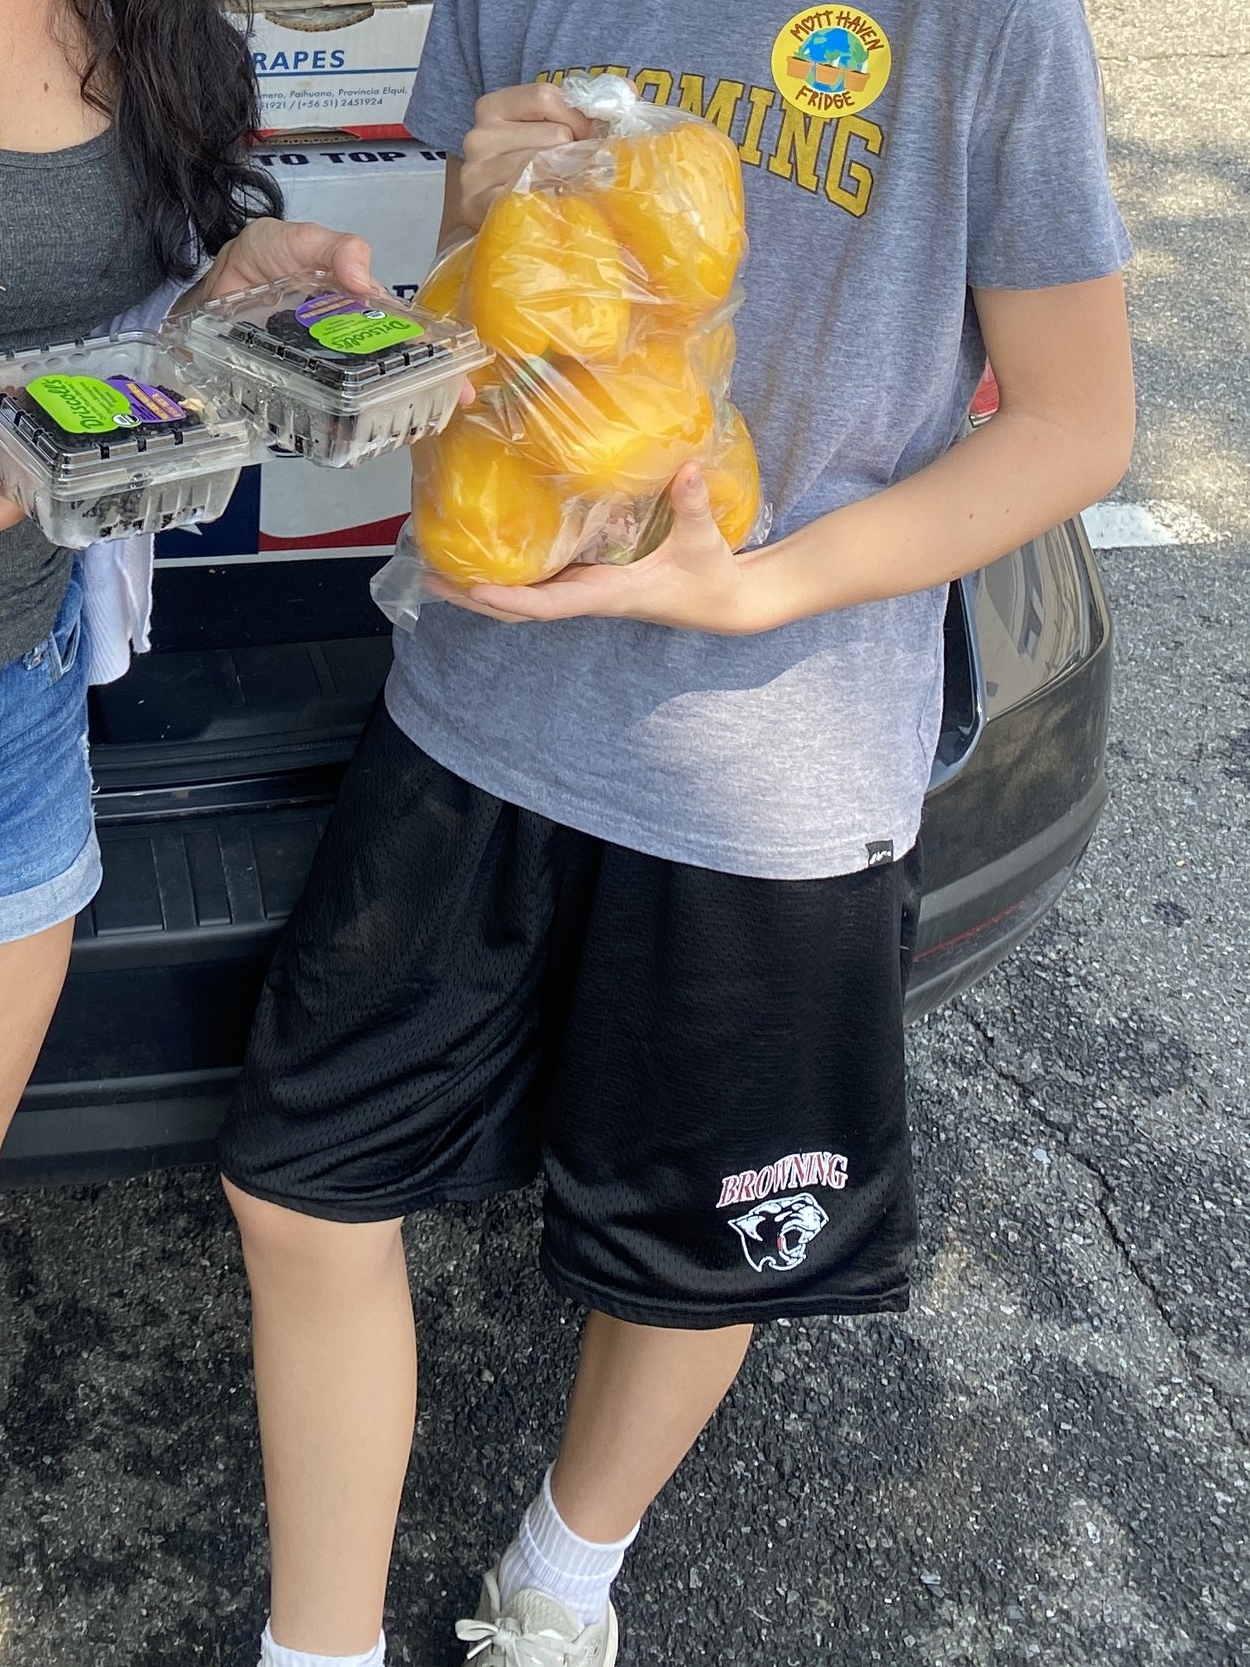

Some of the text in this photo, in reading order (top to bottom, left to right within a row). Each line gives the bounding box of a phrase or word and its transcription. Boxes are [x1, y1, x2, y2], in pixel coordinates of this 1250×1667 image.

[790, 9, 885, 52] MOTT HAVEN
[252, 49, 346, 71] RAPES
[340, 97, 384, 108] 2451924
[253, 152, 310, 167] TO
[319, 150, 407, 164] TOP
[536, 63, 884, 219] OMING
[331, 319, 413, 351] Driscoll's
[42, 378, 105, 429] Driscoll's
[715, 1151, 849, 1209] BROWNING
